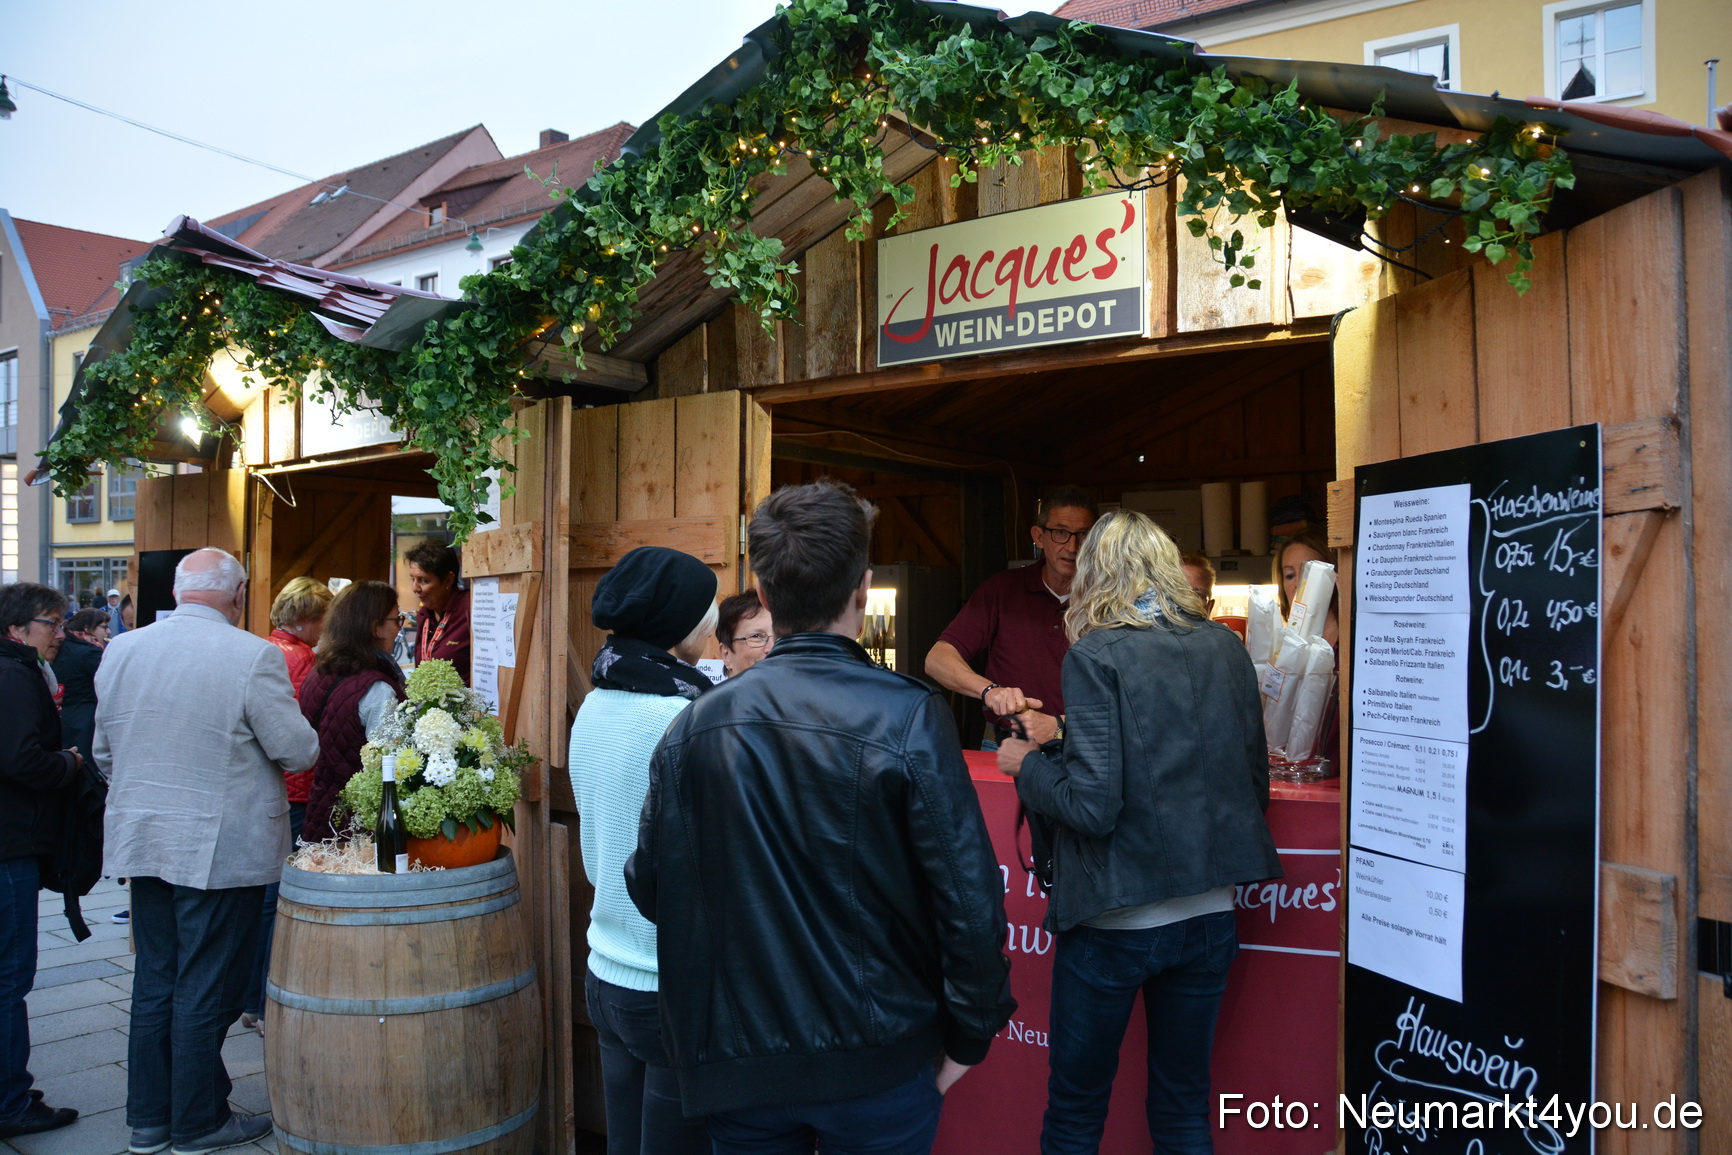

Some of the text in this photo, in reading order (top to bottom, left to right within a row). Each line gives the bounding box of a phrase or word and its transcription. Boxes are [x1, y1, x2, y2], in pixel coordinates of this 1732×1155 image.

[883, 199, 1136, 344] Jacques'
[934, 299, 1117, 348] WEIN-DEPOT
[1394, 498, 1430, 508] Weissweine:
[1374, 513, 1446, 526] Montespina Rueda Spanien
[1373, 526, 1448, 539] Sauvignon blanc Frankreich
[1372, 540, 1454, 552] Chardonnay Frankreich/Italien
[1372, 556, 1378, 564] Le
[1380, 556, 1402, 565] Dauphin
[1404, 554, 1433, 562] Frankreich
[1370, 566, 1450, 578] Grauburgunder Deutschland
[1370, 582, 1392, 590] Riesling
[1369, 594, 1454, 603] Weissburgunder Deutschland
[1394, 620, 1427, 628] Roséweine:
[1396, 636, 1414, 645] Syrah
[1414, 636, 1446, 645] Frankreich
[1370, 646, 1390, 656] Gouyat
[1424, 649, 1455, 658] Frankreich
[1369, 658, 1444, 670] Salbanello Frizzante Italien
[1396, 674, 1424, 684] Rotweine:
[1368, 688, 1398, 698] Salbanello
[1399, 690, 1417, 699] Italien
[1367, 700, 1412, 710] Primitivo Italien
[1410, 716, 1441, 726] Frankreich
[1360, 736, 1384, 747] Prosecco
[1387, 740, 1411, 750] Crémant:
[1442, 749, 1454, 758] 0,75
[1396, 786, 1424, 798] MAGNUM
[1356, 857, 1374, 868] PFAND
[1356, 872, 1384, 885] Weinkühler
[1444, 894, 1448, 902] €
[1356, 886, 1392, 902] Mineralwasser
[1443, 910, 1448, 919] €
[1361, 912, 1446, 946] Alle Preise solange Vorrat hält
[1396, 995, 1538, 1101] Hauswein
